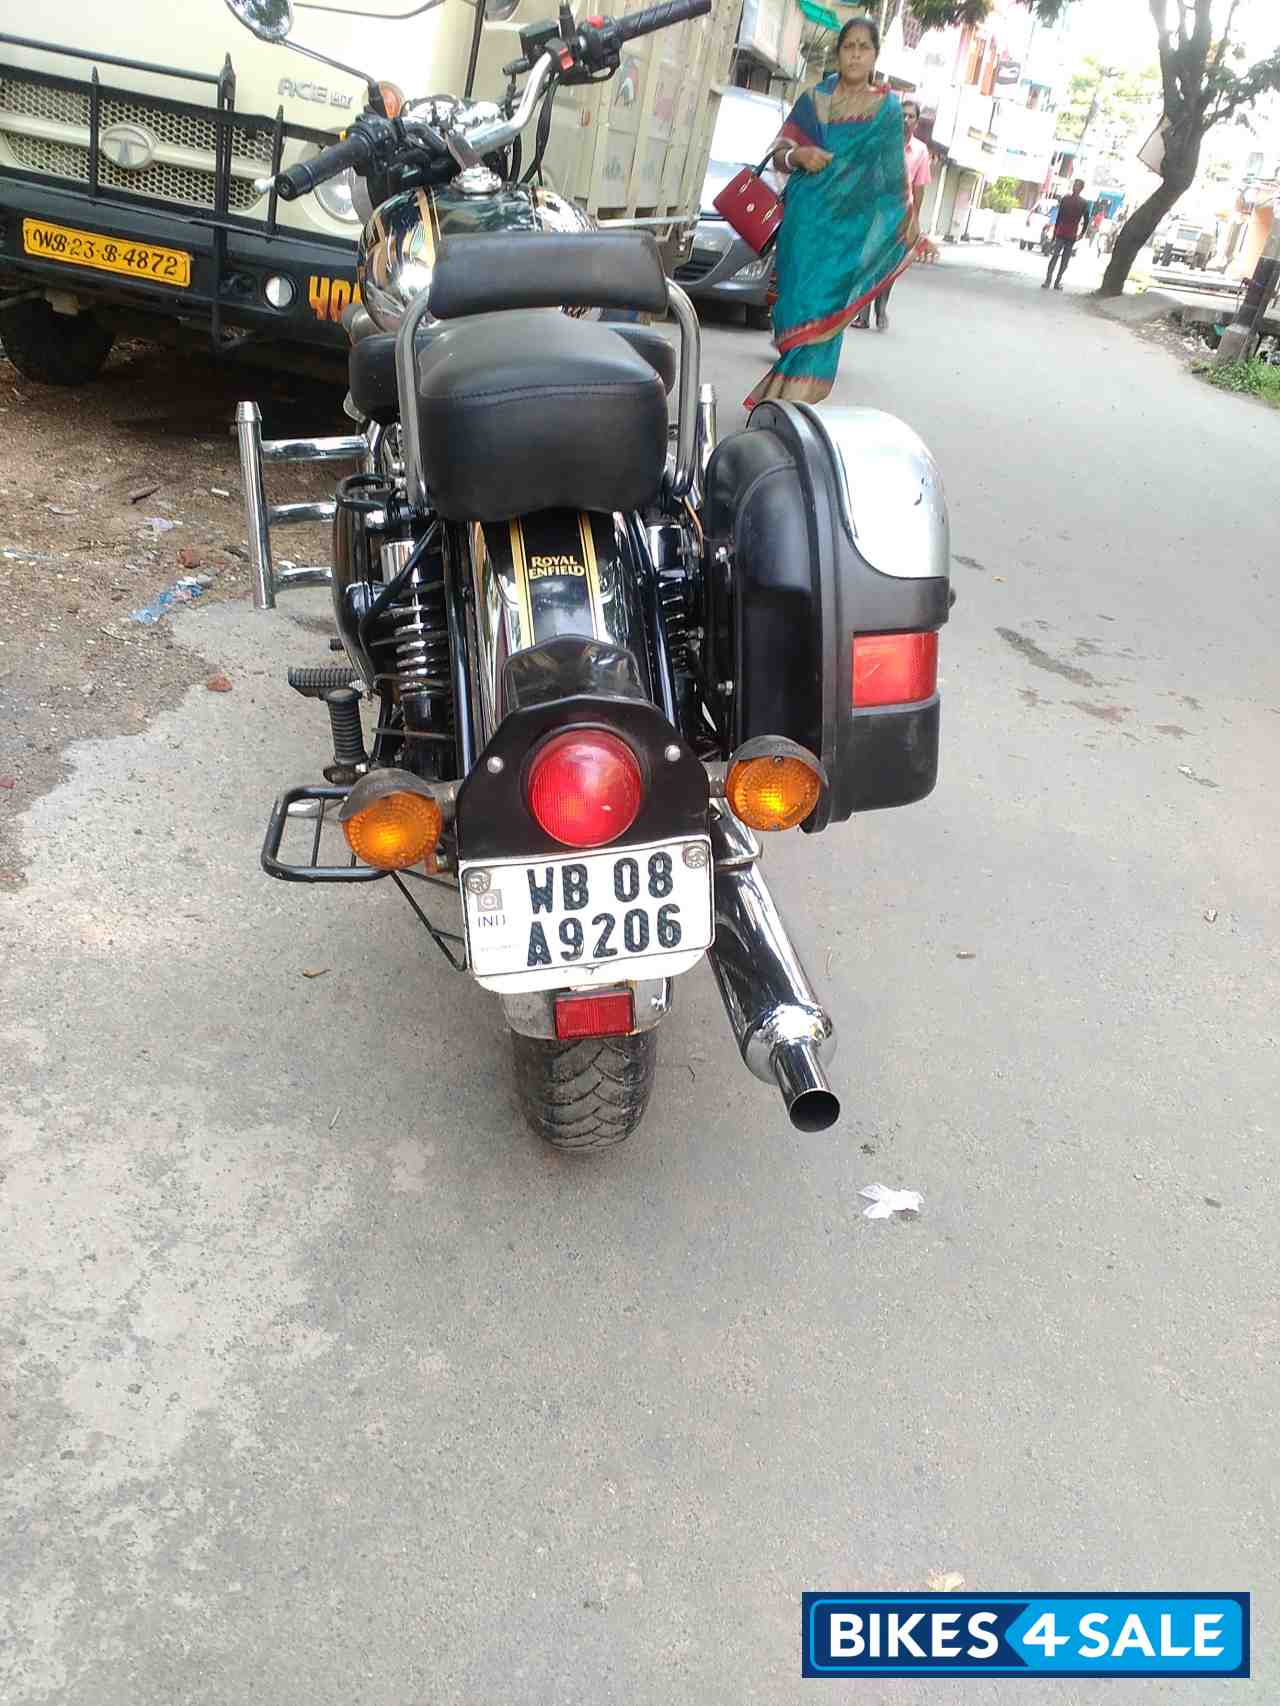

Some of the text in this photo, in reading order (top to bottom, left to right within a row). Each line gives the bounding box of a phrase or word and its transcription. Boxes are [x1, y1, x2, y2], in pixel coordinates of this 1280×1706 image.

[529, 565, 585, 580] ENFIELD
[531, 555, 578, 568] ROYAL
[527, 851, 673, 914] WB 08
[527, 903, 682, 967] A9206
